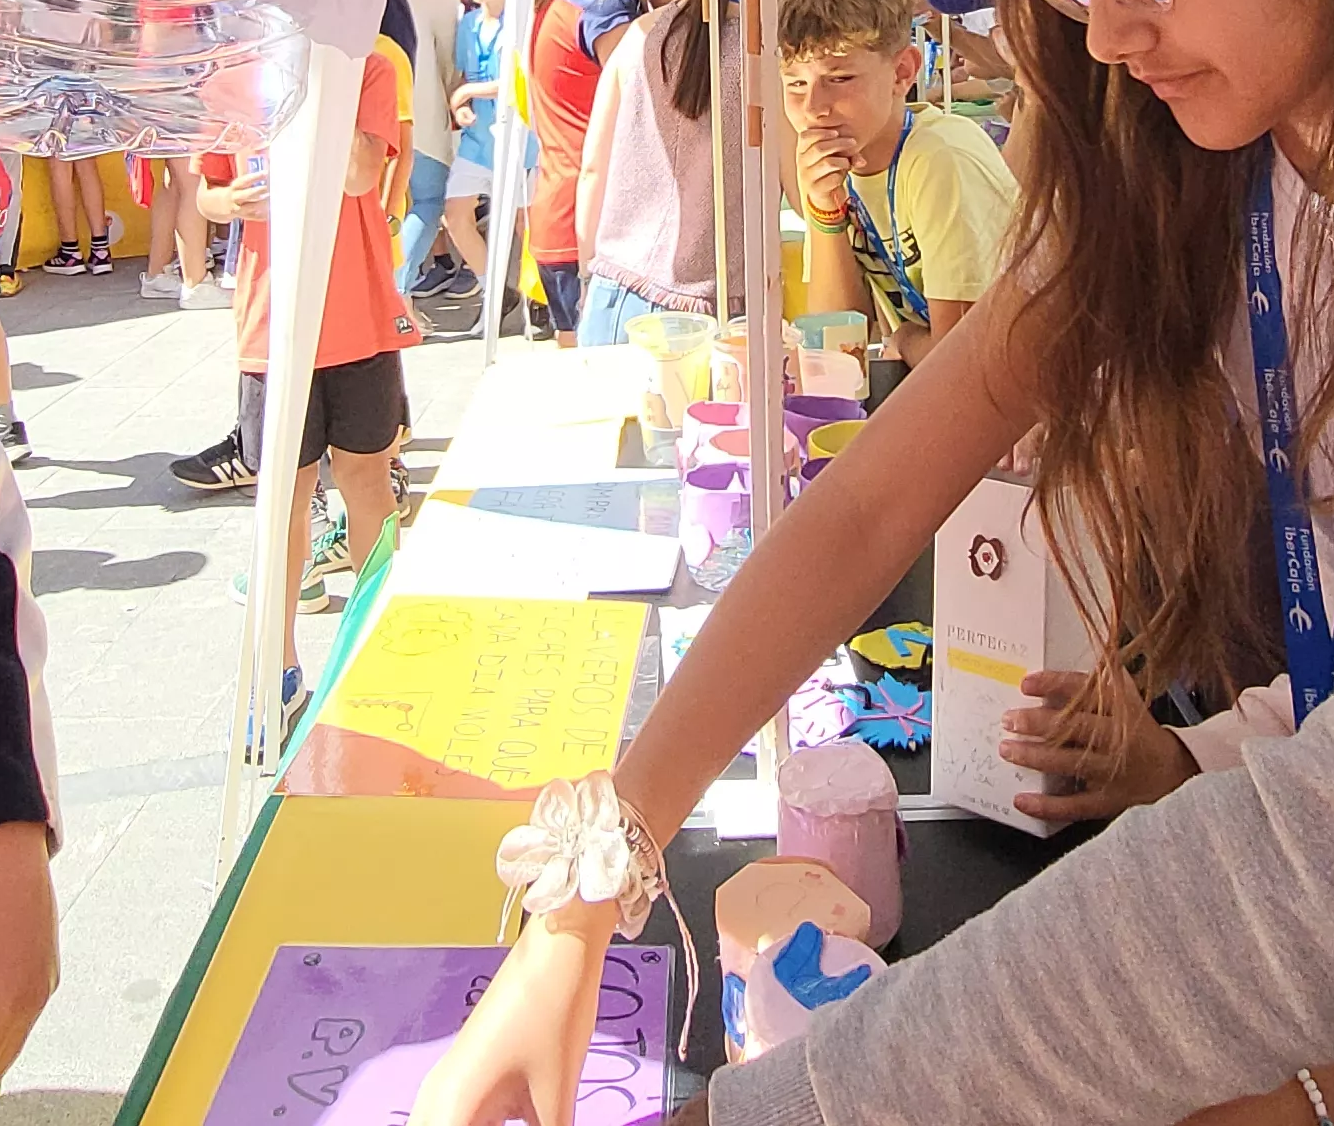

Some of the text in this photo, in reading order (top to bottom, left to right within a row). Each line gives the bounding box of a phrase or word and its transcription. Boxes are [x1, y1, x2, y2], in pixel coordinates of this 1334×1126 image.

[1299, 528, 1316, 591] Fundación
[508, 688, 556, 729] PARA
[487, 740, 538, 783] QUE
[562, 727, 609, 757] DE
